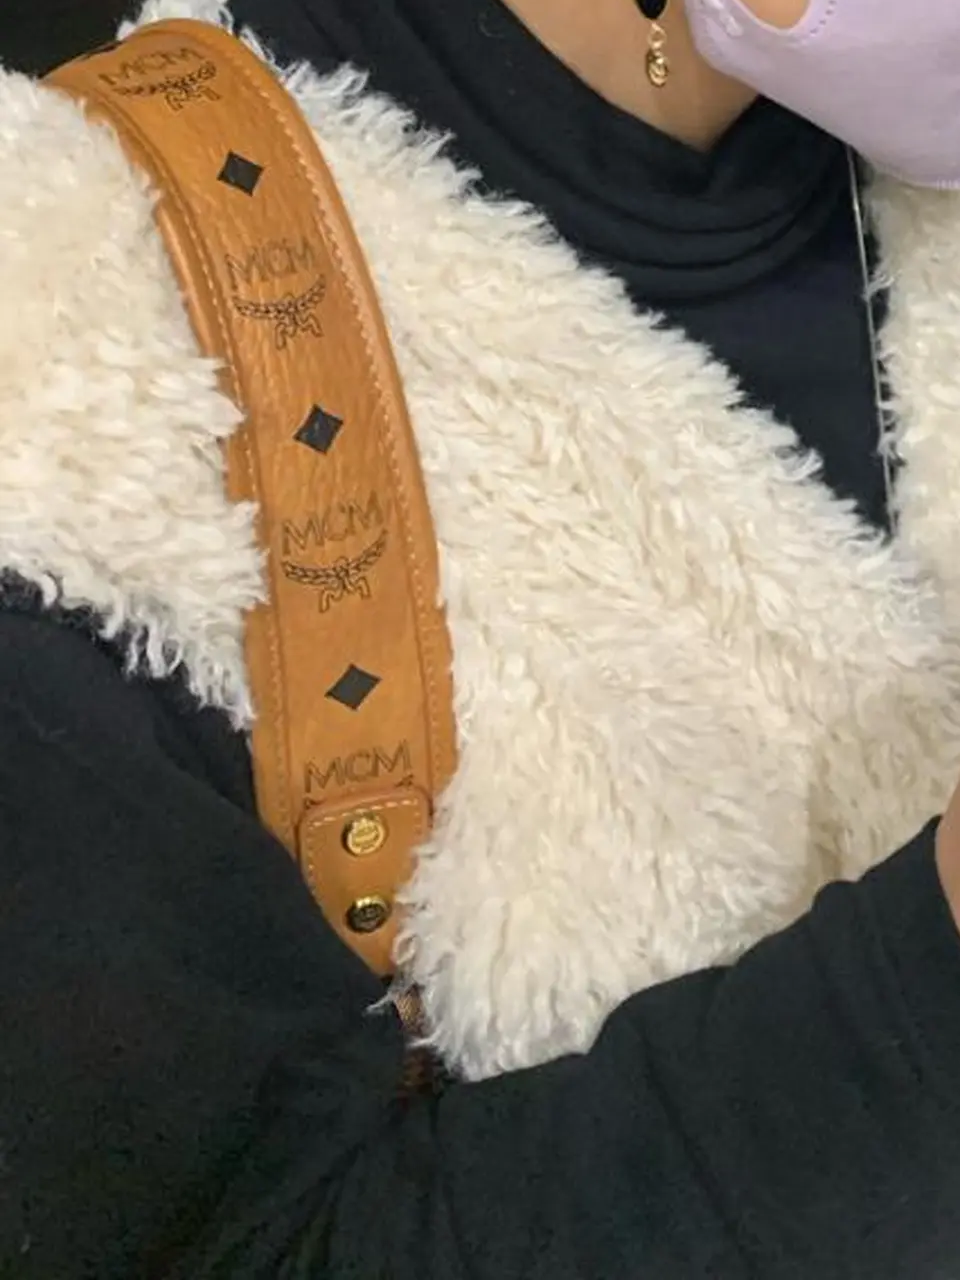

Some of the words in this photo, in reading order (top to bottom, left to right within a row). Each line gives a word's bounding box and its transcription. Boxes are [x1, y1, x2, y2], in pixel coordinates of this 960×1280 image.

[98, 48, 204, 86] MCM
[224, 237, 316, 291] MCM
[281, 489, 384, 556] MCM
[303, 739, 412, 793] MCM
